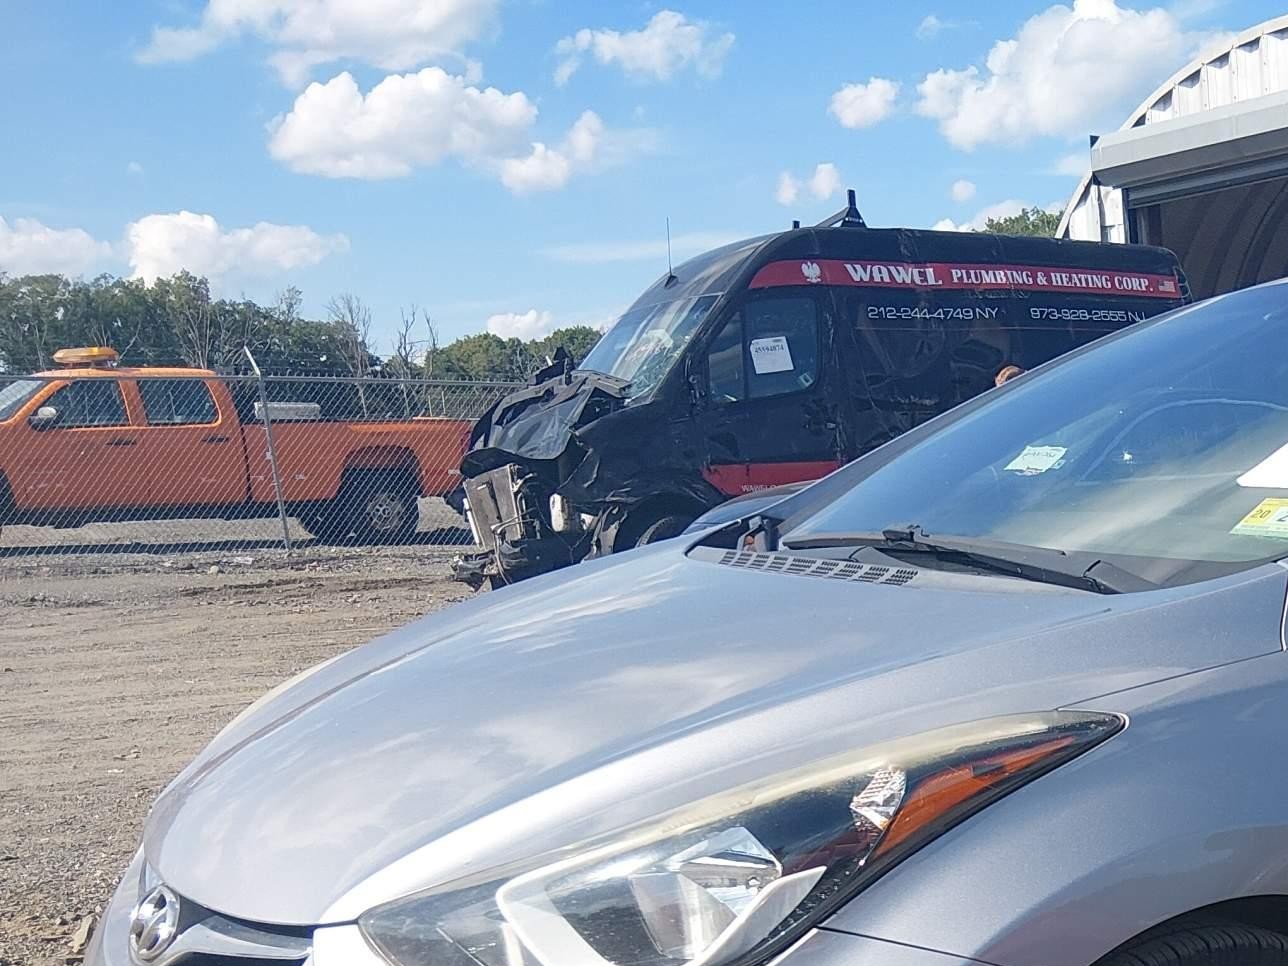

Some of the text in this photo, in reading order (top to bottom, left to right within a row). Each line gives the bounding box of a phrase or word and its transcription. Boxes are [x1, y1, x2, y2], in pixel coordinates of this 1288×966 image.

[843, 263, 1154, 292] WAWEL PLUMBING & HEATING CORP.
[868, 306, 998, 320] 212-244-4749 NY
[1250, 509, 1272, 519] 20
